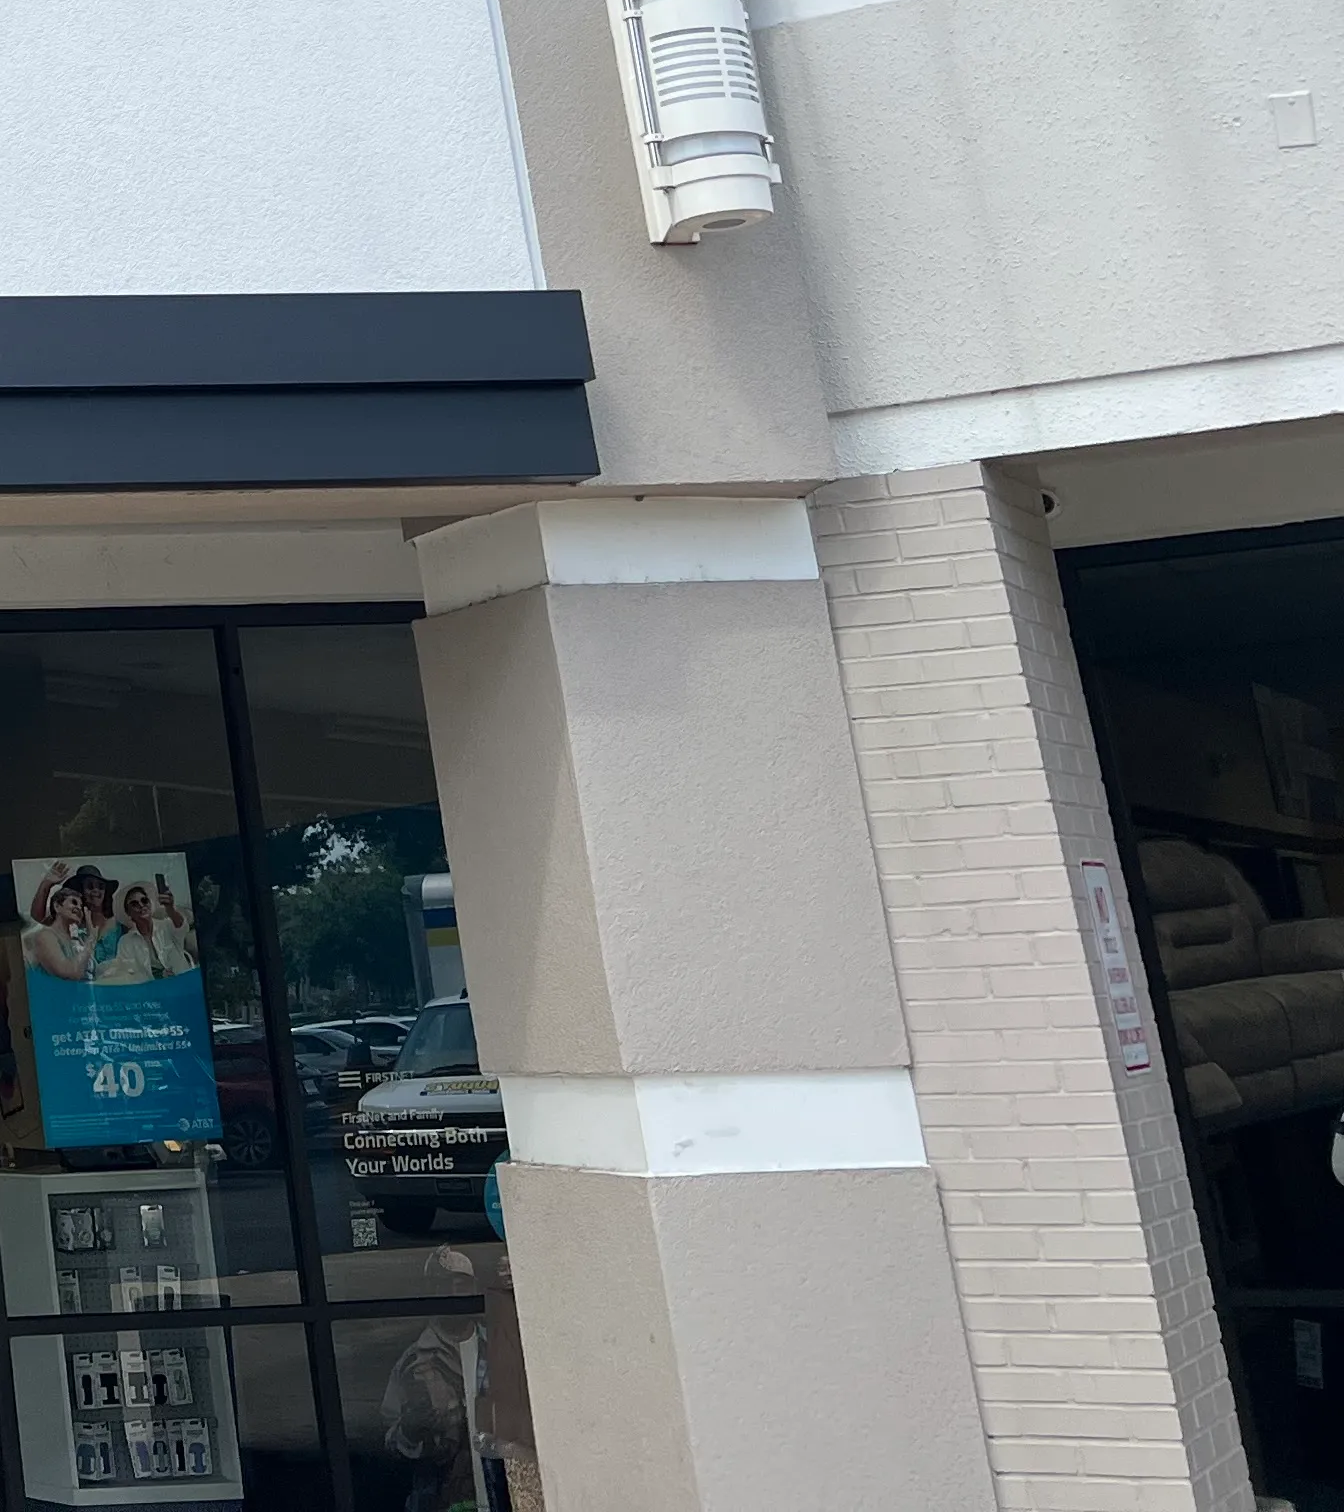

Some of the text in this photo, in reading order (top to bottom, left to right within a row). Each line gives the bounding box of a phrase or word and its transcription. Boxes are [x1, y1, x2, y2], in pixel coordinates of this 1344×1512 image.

[52, 1032, 72, 1046] get
[76, 1029, 107, 1042] AT&T
[85, 1061, 145, 1099] $40
[191, 1118, 214, 1129] AT&T
[342, 1108, 444, 1125] FirstNet and Family
[344, 1126, 488, 1150] Connecting Both
[345, 1152, 454, 1175] Your Worlds
